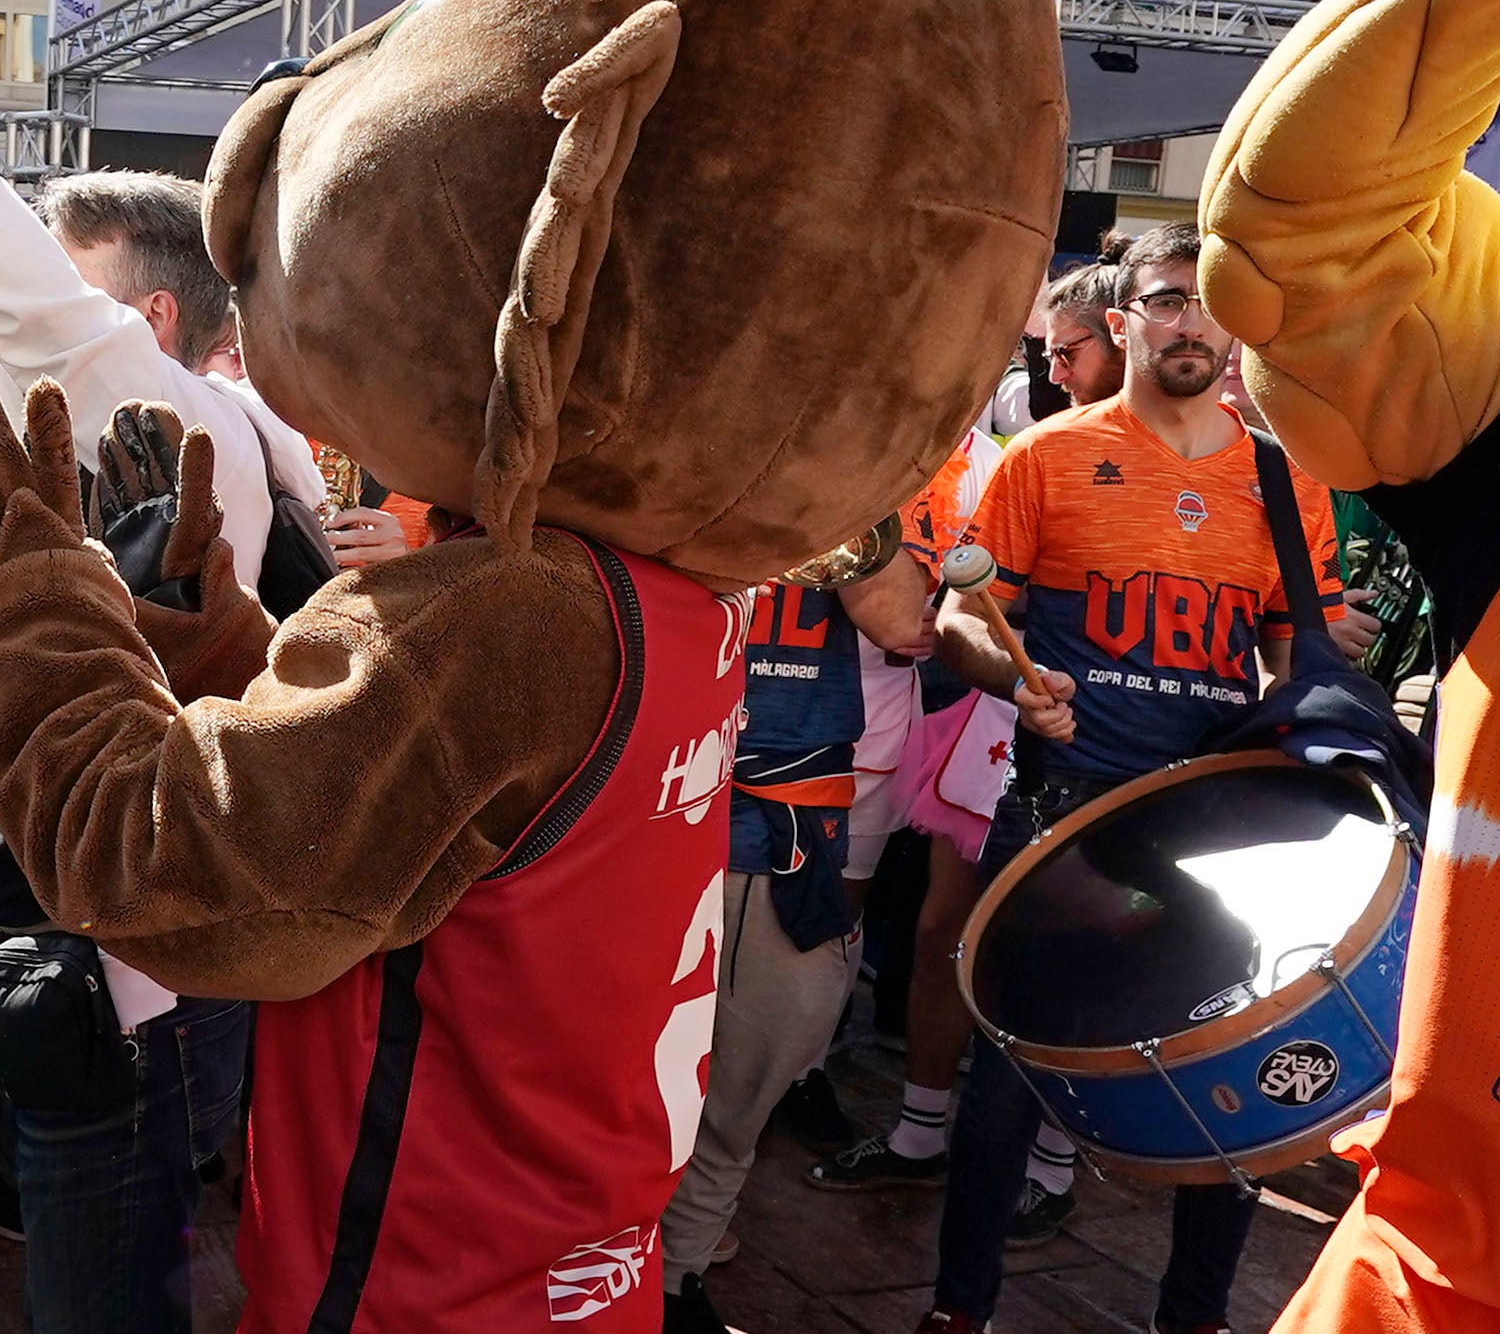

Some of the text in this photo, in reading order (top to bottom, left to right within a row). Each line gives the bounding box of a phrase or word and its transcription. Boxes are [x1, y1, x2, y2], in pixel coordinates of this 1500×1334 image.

[1086, 668, 1123, 685] COPA
[1126, 673, 1154, 693] DEL
[1158, 678, 1182, 696] REI
